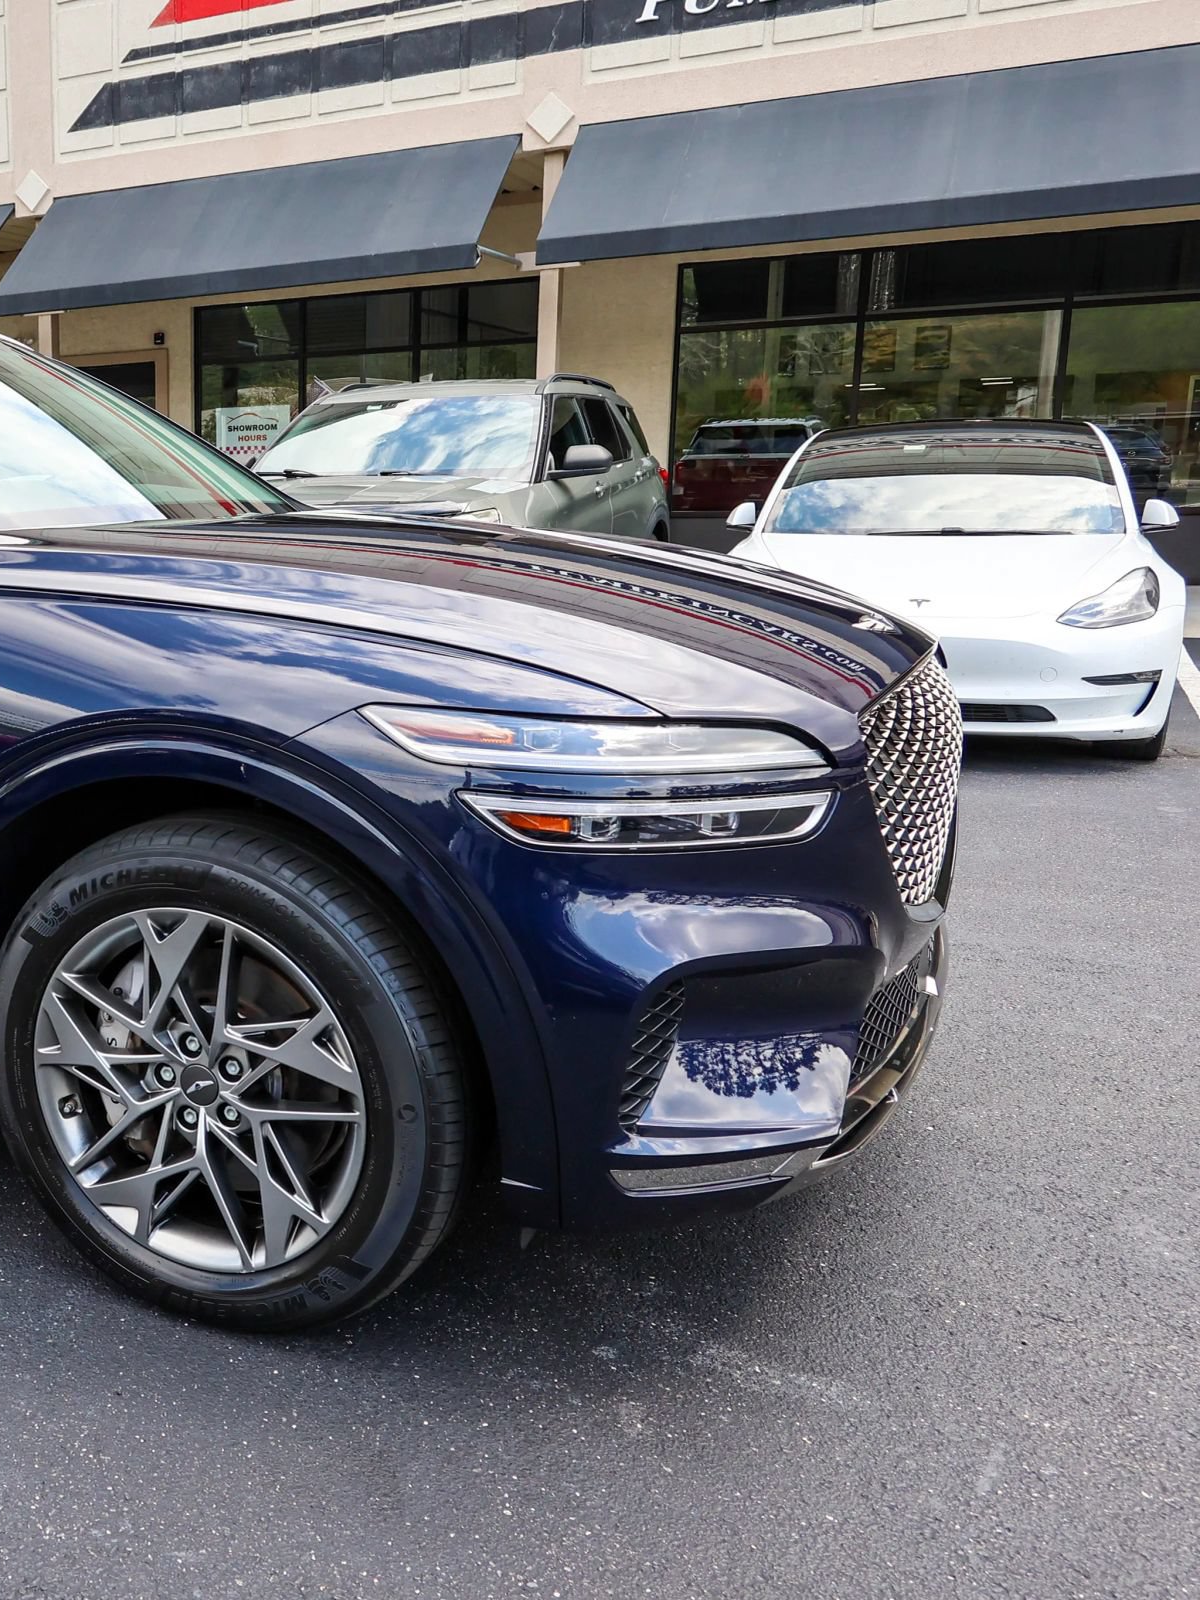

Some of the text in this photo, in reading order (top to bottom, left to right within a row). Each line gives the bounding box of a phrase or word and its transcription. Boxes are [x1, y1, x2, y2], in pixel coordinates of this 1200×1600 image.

[227, 423, 278, 432] SHOWROOM
[237, 434, 267, 442] HOURS
[68, 865, 205, 906] MICHE
